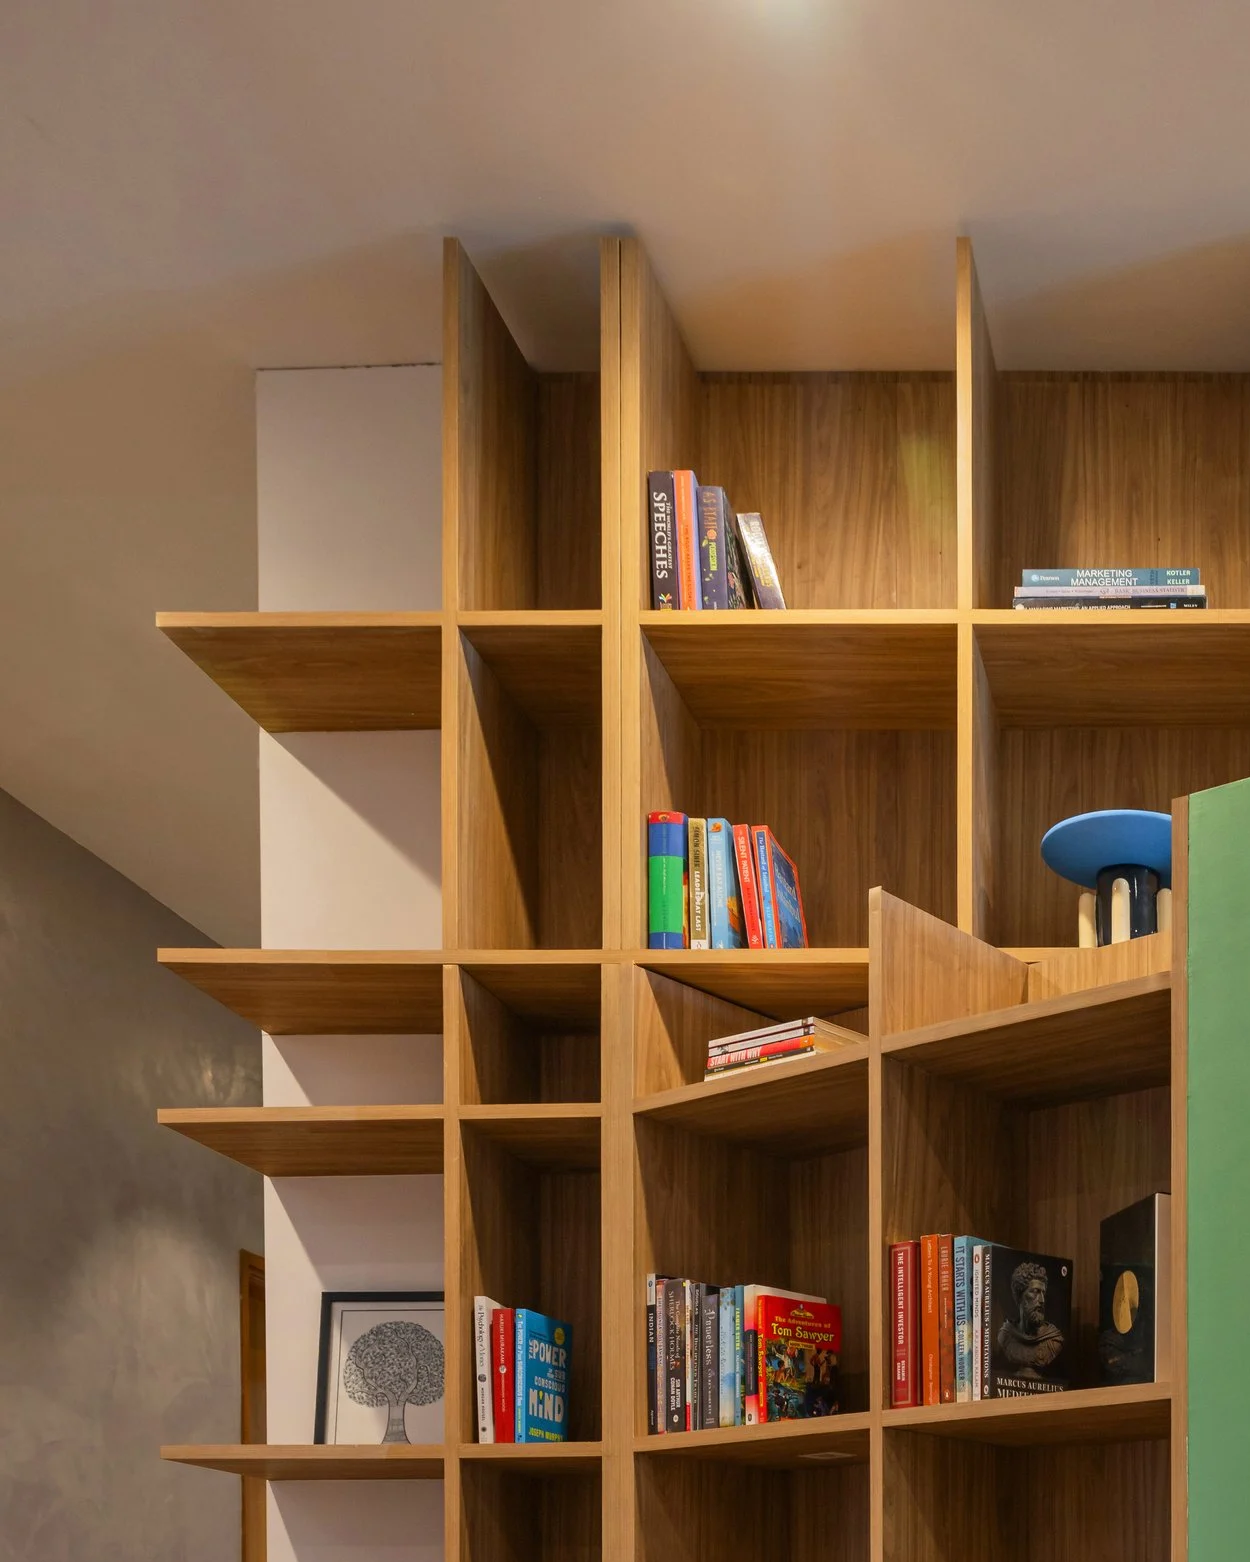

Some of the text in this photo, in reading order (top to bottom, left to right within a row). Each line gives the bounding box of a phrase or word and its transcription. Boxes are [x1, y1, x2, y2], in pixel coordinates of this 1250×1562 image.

[653, 492, 668, 579] SPEECHES
[1071, 578, 1138, 586] MANAGEMENT
[737, 836, 750, 883] SILENT PATIENT
[710, 1055, 730, 1067] START
[730, 1051, 746, 1063] WITH
[747, 1047, 761, 1059] WHY
[955, 1246, 966, 1326] IT STARTS WITH US
[476, 1312, 485, 1343] Psychology
[668, 1291, 676, 1336] SHERLOCK
[787, 1318, 822, 1328] Adventures
[771, 1323, 835, 1343] Tom Sawyer
[533, 1339, 567, 1368] POWER
[996, 1377, 1064, 1392] MARCUS AURELIUS
[529, 1388, 564, 1423] MIND
